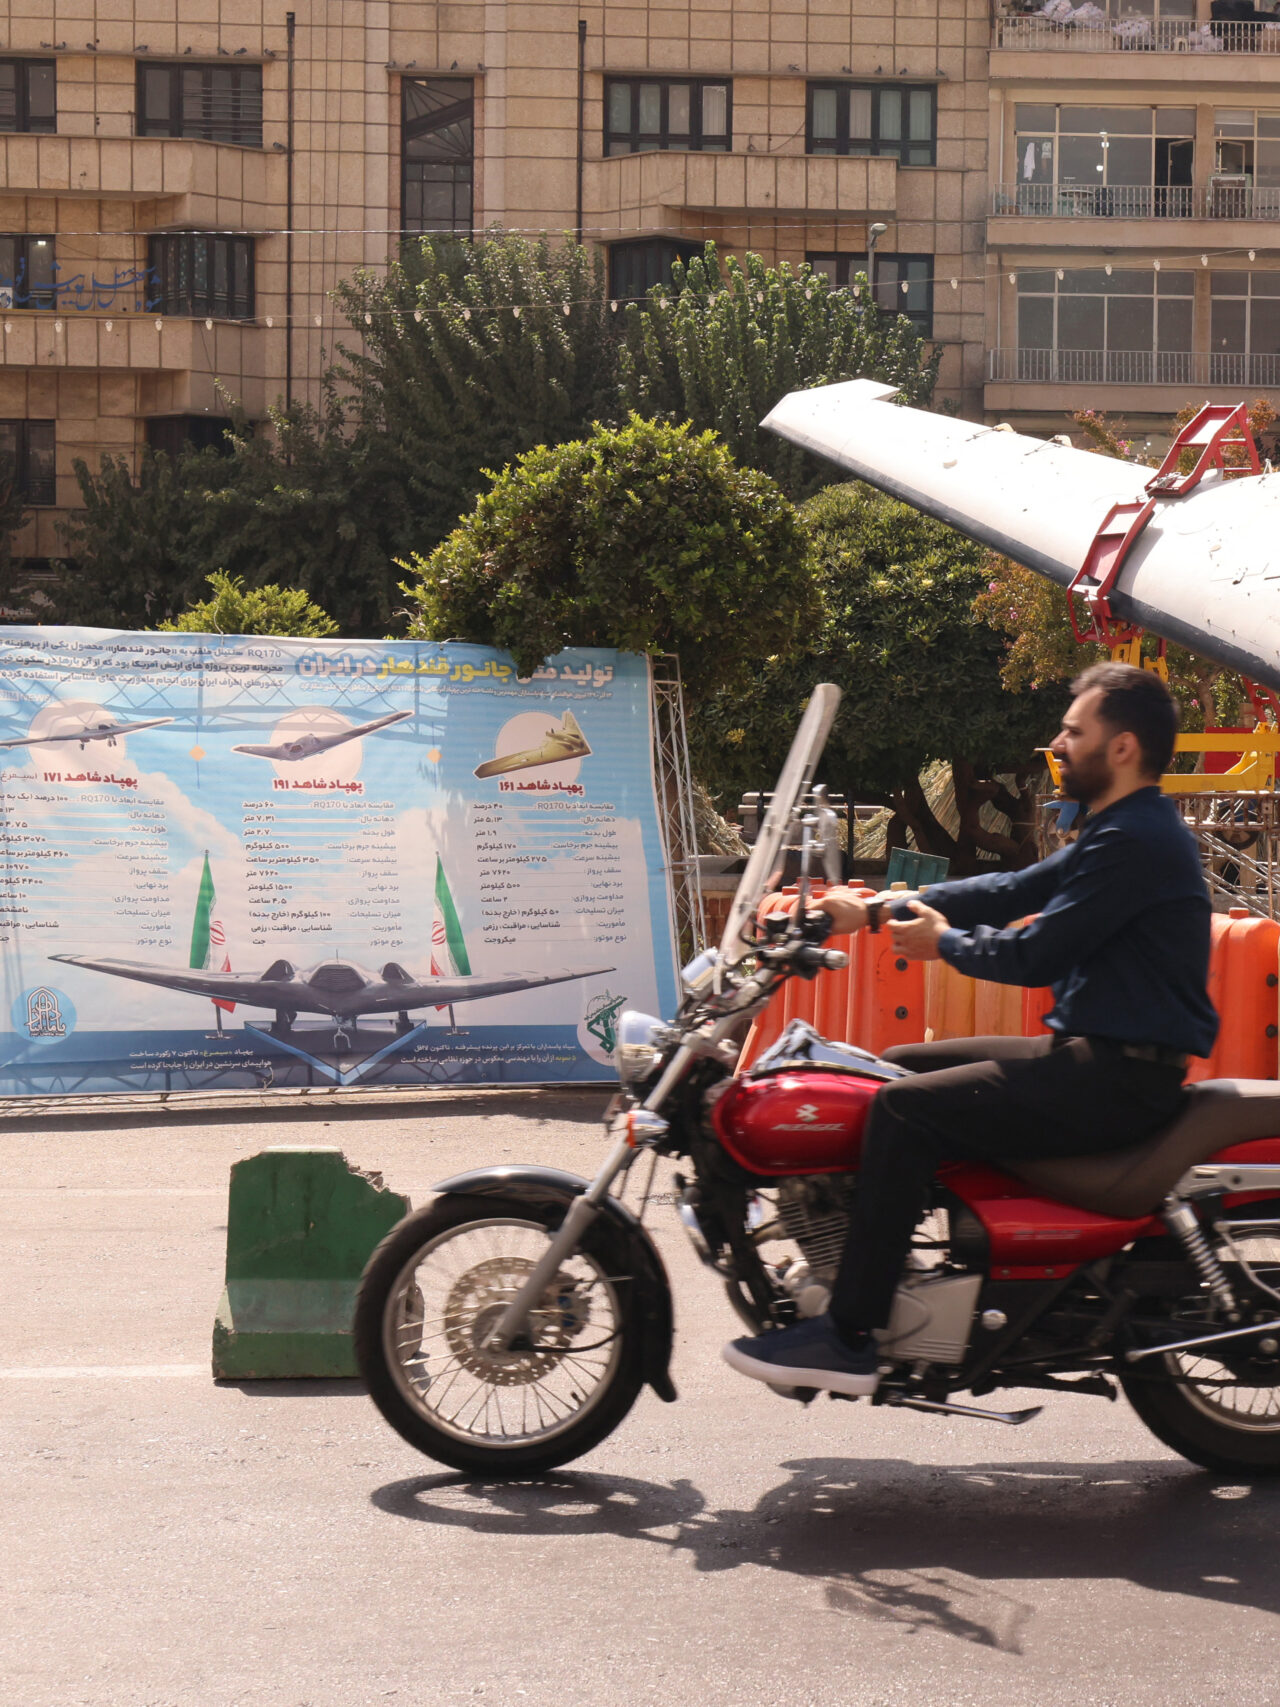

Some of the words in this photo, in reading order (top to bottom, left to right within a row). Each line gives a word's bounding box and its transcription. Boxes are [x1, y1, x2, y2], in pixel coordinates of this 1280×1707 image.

[161, 662, 182, 670] ارتش
[185, 662, 203, 670] های
[205, 664, 228, 672] پروژه
[252, 664, 283, 673] محرمانه
[300, 656, 350, 678] ایران
[352, 659, 376, 678] در
[377, 657, 449, 681] قندهار
[450, 661, 512, 682] جانور
[560, 664, 613, 687] تولید
[44, 772, 61, 782] ۱۷۱
[65, 772, 101, 782] شاهد
[103, 774, 137, 790] پهپاد
[274, 780, 289, 790] ۱۹۱
[292, 778, 327, 789] شاهد
[329, 779, 363, 794] پهپاد
[500, 782, 514, 791] ۱۶۱
[517, 780, 550, 791] شاهد
[552, 780, 584, 796] پهپاد
[602, 829, 616, 838] طول
[245, 842, 273, 850] کیلوگرم
[477, 843, 503, 851] کیلوگرم
[522, 908, 548, 917] کیلوگرم
